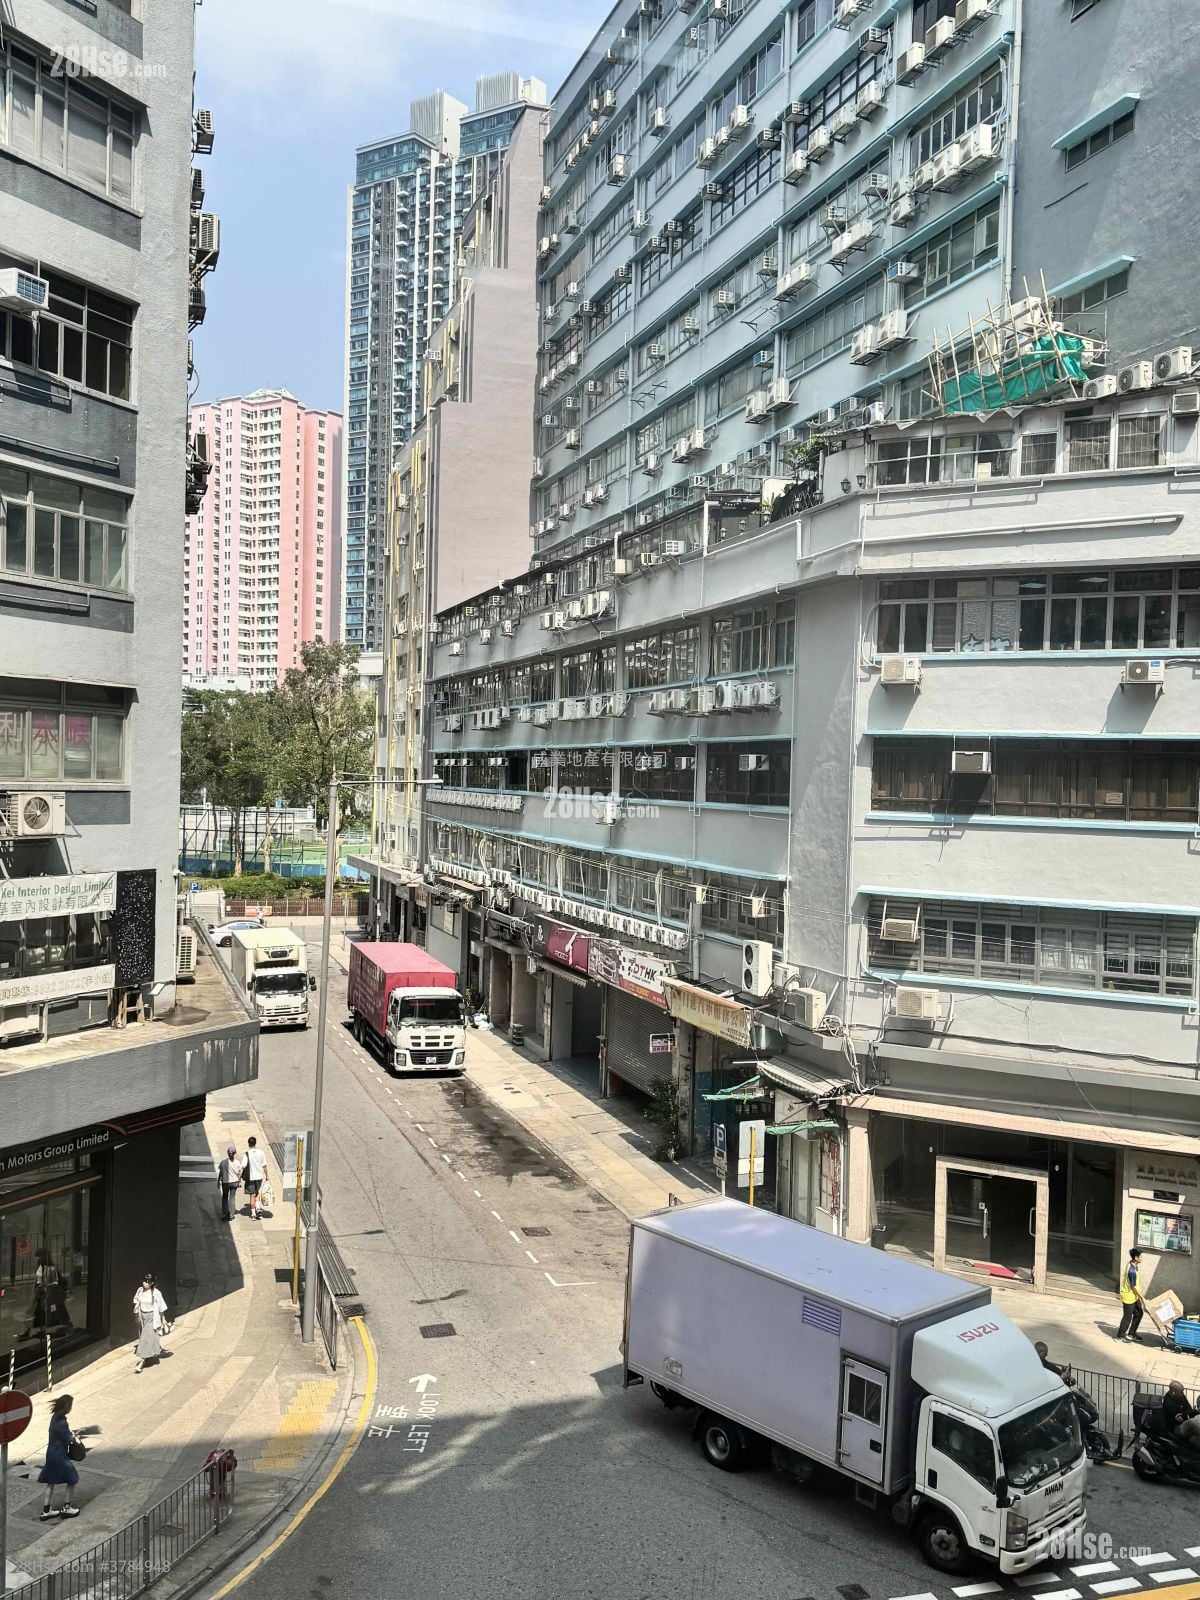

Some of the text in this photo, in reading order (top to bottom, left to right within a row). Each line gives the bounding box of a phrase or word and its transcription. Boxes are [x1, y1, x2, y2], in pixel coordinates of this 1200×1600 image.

[1, 879, 113, 898] Kei Interior Design Limited
[633, 963, 658, 982] DTHK
[716, 1128, 725, 1148] P
[8, 1151, 42, 1169] Motors
[43, 1143, 74, 1158] Group
[76, 1131, 109, 1149] Limited
[956, 1322, 999, 1343] ISUZU
[403, 1393, 442, 1453] LOOK LEFT
[1044, 1481, 1064, 1497] AWAN
